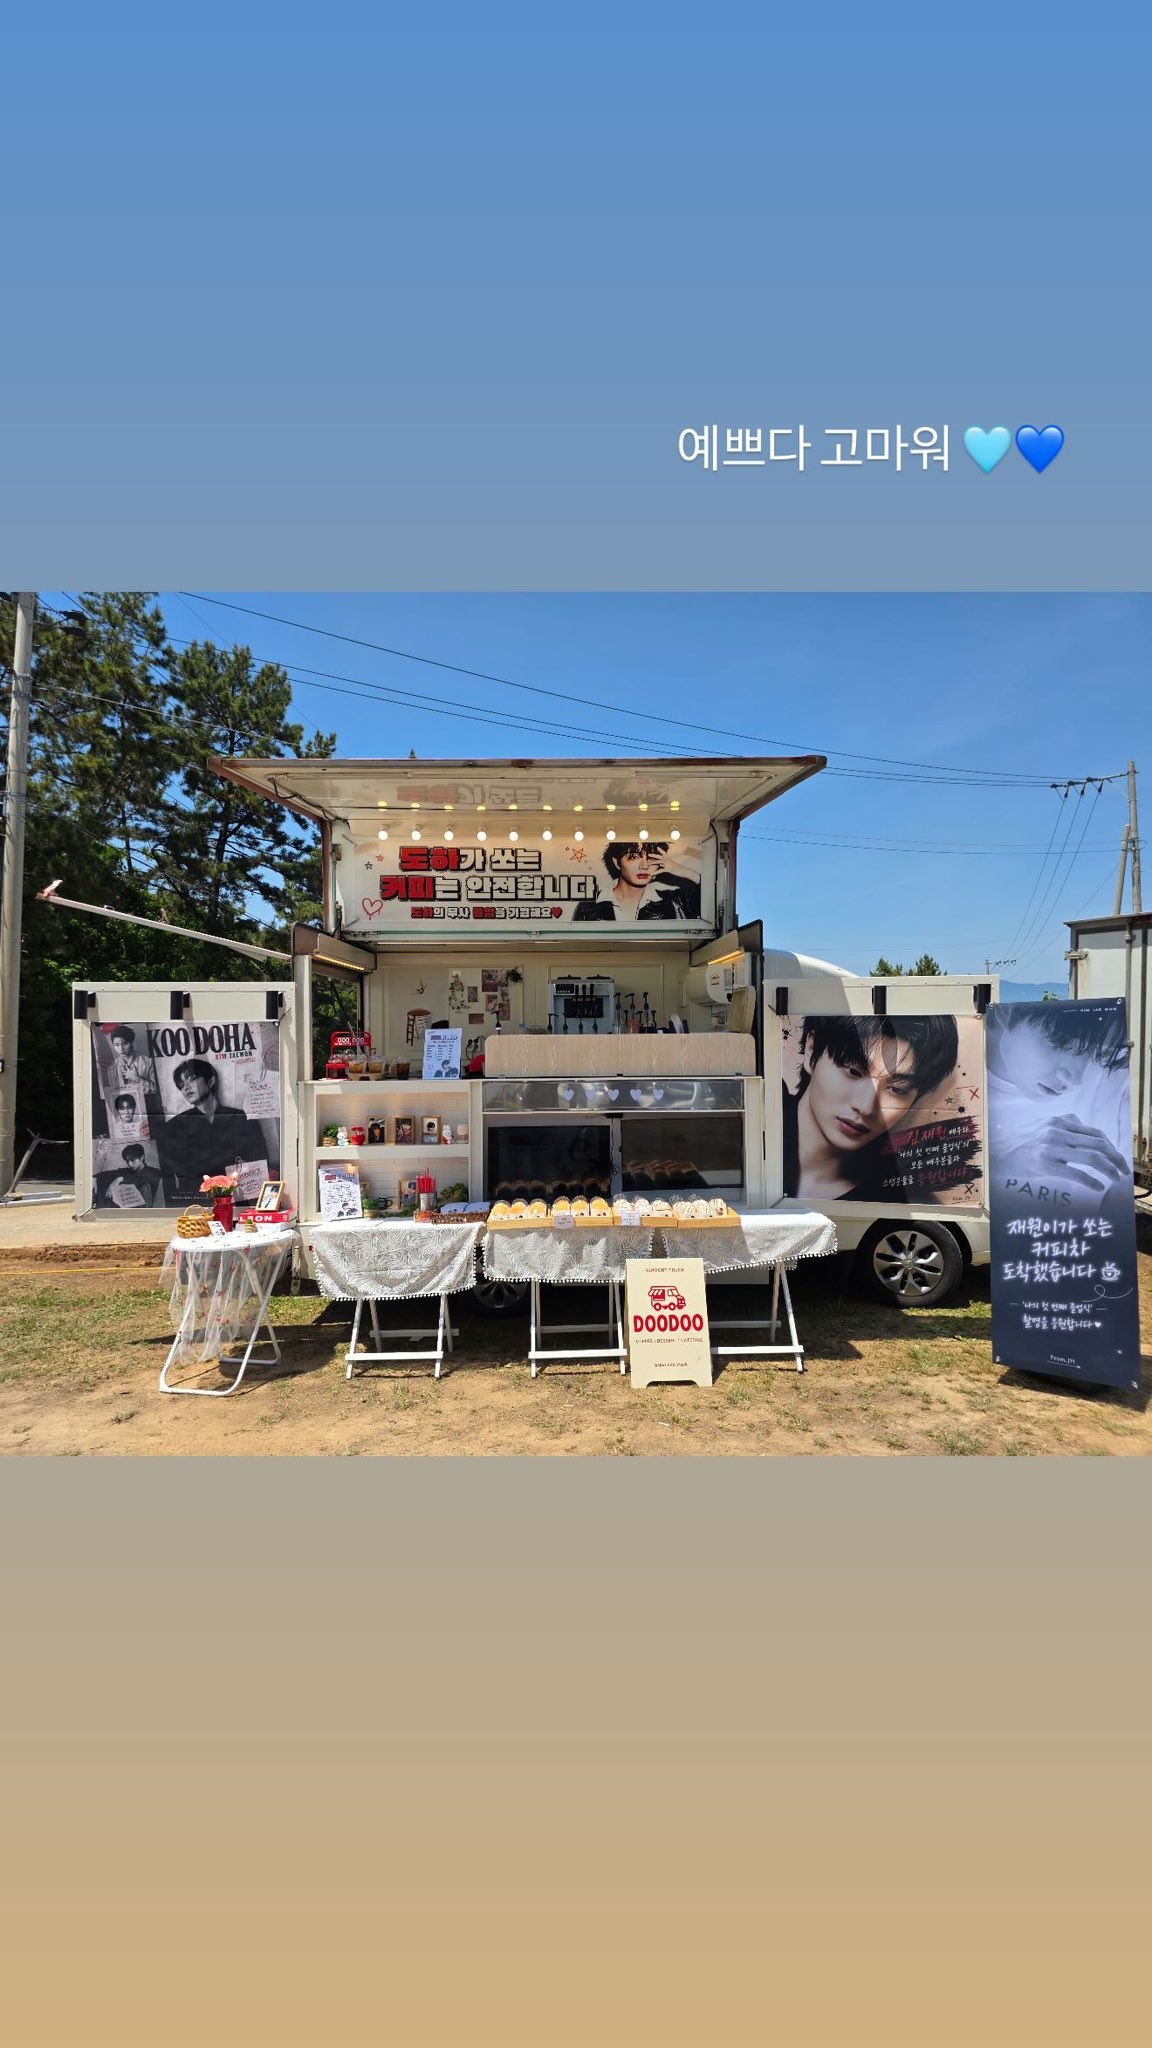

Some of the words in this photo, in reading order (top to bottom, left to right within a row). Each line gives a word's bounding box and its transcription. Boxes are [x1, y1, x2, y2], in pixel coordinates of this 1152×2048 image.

[399, 846, 485, 872] 도하가
[489, 847, 542, 872] 쏘는
[379, 875, 462, 901] 커피는
[465, 875, 597, 901] 안전합니다
[146, 1028, 191, 1058] KOO
[192, 1023, 257, 1055] DOHA
[1005, 1179, 1072, 1207] PARIS
[1006, 1217, 1078, 1238] 재원이가
[1083, 1217, 1113, 1237] 쏘는
[1031, 1237, 1091, 1258] 커피차
[1002, 1260, 1097, 1283] 도착했습니다
[1041, 1301, 1049, 1311] 첫
[1051, 1302, 1068, 1312] 번째
[633, 1313, 704, 1332] DOODOO
[1022, 1313, 1049, 1329] 촬영을
[1051, 1316, 1093, 1331] 응원합니다
